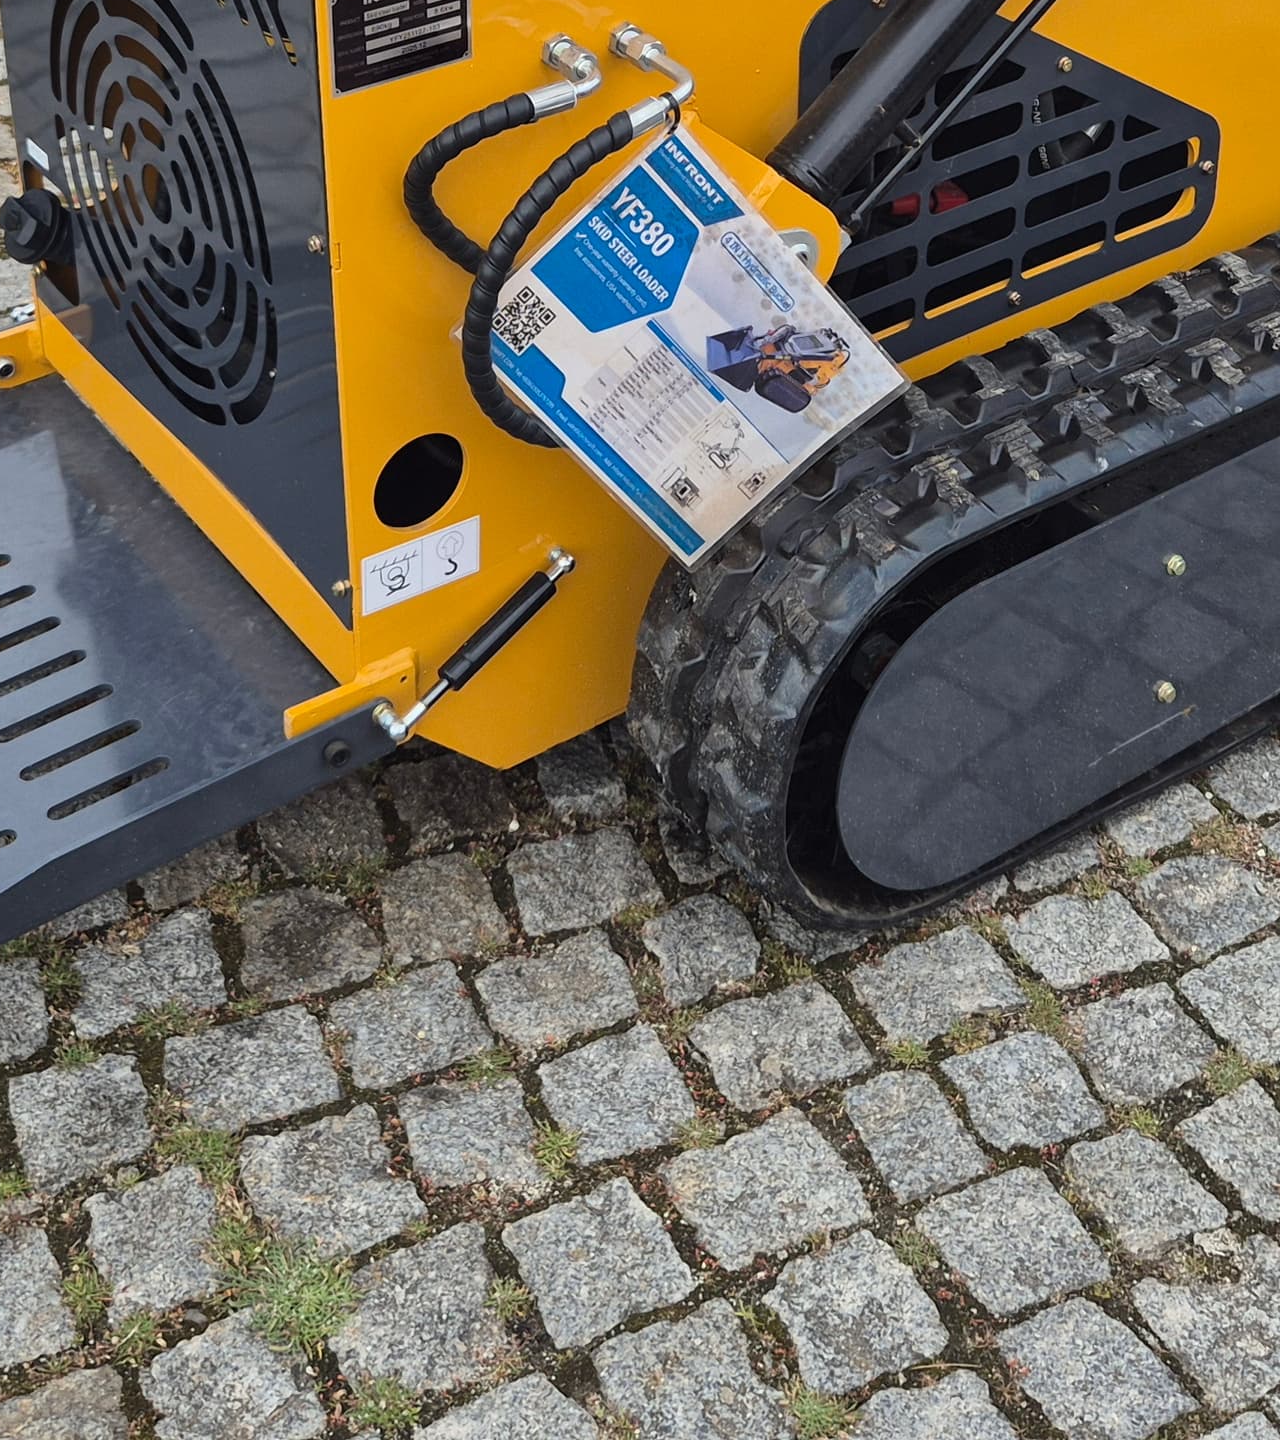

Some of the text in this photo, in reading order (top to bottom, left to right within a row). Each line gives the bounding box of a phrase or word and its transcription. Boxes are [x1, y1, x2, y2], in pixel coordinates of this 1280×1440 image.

[663, 140, 724, 206] INFRONT
[587, 214, 670, 303] SKID STEER LOADER
[607, 184, 677, 260] YF380
[723, 234, 733, 244] 4
[729, 240, 741, 253] IN
[740, 255, 773, 289] Hydraulic
[768, 284, 792, 309] Bucket
